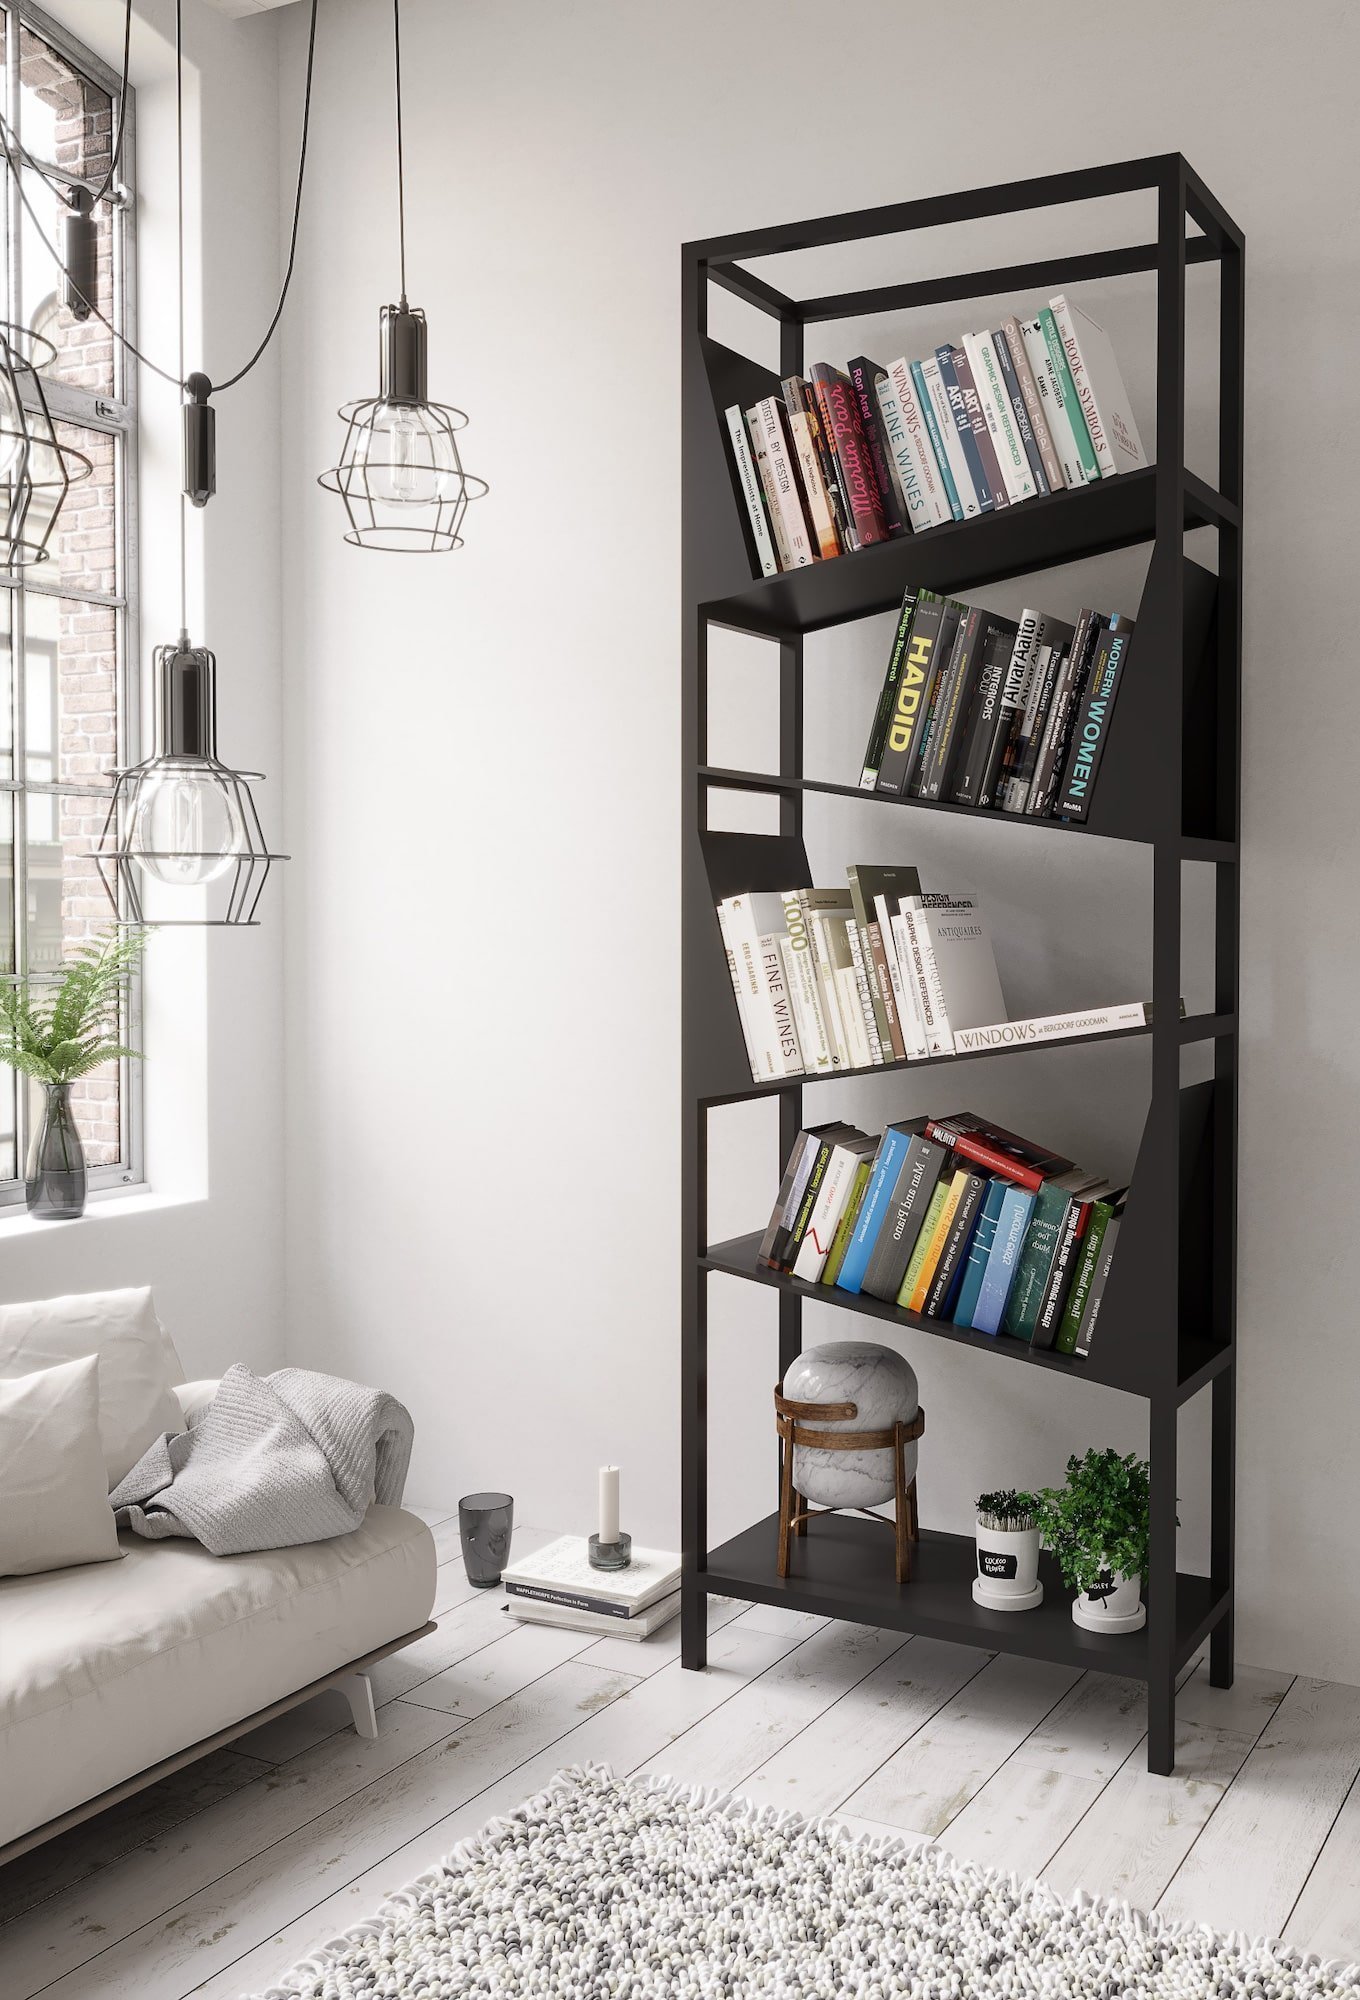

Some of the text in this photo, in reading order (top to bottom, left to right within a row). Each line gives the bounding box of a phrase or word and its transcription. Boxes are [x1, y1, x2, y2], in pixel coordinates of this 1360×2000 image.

[1058, 324, 1068, 338] THE
[1043, 358, 1054, 376] ARNE
[1063, 337, 1084, 376] BOOK
[852, 368, 872, 419] Ron Arad
[946, 384, 964, 411] ART
[1036, 375, 1049, 397] EAMES
[1048, 375, 1064, 408] JACOBSEN
[1075, 377, 1082, 387] OF
[830, 385, 852, 438] Parr
[962, 386, 980, 414] ART
[979, 346, 997, 383] GRAPHIC
[990, 382, 1006, 413] DESIGN
[999, 413, 1022, 466] REFERENCED
[892, 364, 936, 494] WINDOWS BERGDORF GOODMAN
[1010, 396, 1032, 442] BORDEAUX
[1077, 386, 1107, 453] SYMBOLS
[733, 429, 743, 444] The
[759, 399, 791, 493] DIGITAL BY DESIGN
[925, 410, 935, 428] FRANK
[931, 428, 940, 446] LLOYD
[936, 446, 947, 469] WRIGHT
[882, 400, 924, 511] FINE WINES
[734, 445, 758, 503] Impressionists
[803, 454, 819, 495] Ben Nicholson
[844, 440, 872, 517] Martin
[751, 503, 758, 512] at
[763, 467, 781, 516] ARCHITECTURE
[753, 513, 764, 536] Home
[896, 605, 913, 638] Design
[886, 639, 905, 682] Research
[957, 652, 969, 676] Helvetica
[882, 634, 937, 753] HADID
[929, 669, 950, 720] Conversations
[976, 663, 994, 695] NOW!
[980, 665, 1004, 721] INTERIORS
[1037, 650, 1061, 712] Picasso Guitars
[947, 706, 956, 718] York
[950, 694, 959, 707] New
[944, 717, 953, 728] City
[1048, 690, 1070, 750] tangled alphabets
[1065, 637, 1125, 798] MODERN WOMEN
[918, 736, 934, 772] Architects
[939, 727, 951, 748] Subway
[935, 747, 946, 766] System
[1014, 789, 1025, 810] MoMA
[1033, 790, 1044, 809] MoMA
[1062, 802, 1082, 812] MoMA
[781, 896, 809, 952] 1000
[859, 927, 870, 949] FRANK
[938, 926, 982, 937] ANTIQUAIRES
[742, 942, 759, 995] EERO SAARINEN
[782, 944, 798, 989] MAKING IT
[801, 950, 810, 965] designs
[804, 965, 812, 975] for
[864, 949, 875, 972] LLOYD
[901, 945, 912, 974] Contemporary
[904, 911, 934, 1026] GRAPHIC DESIGN REFERENCED
[795, 952, 804, 973] Geraldine
[802, 990, 811, 1004] Rudge
[845, 923, 865, 971] ALEXEY
[855, 974, 881, 1055] BRODOVITCH
[868, 971, 880, 1000] WRIGHT
[876, 963, 896, 1024] Gardens in France
[924, 945, 947, 1018] ANTIQUAIRES
[762, 953, 797, 1058] FINE WINES
[811, 1001, 819, 1011] and
[813, 1011, 821, 1024] where
[960, 1016, 1108, 1048] WINDOWS BERGDORF GOODMAN
[933, 1128, 956, 1148] MALDITO
[516, 1586, 589, 1608] MAPPLETHORPE Perfection Form
